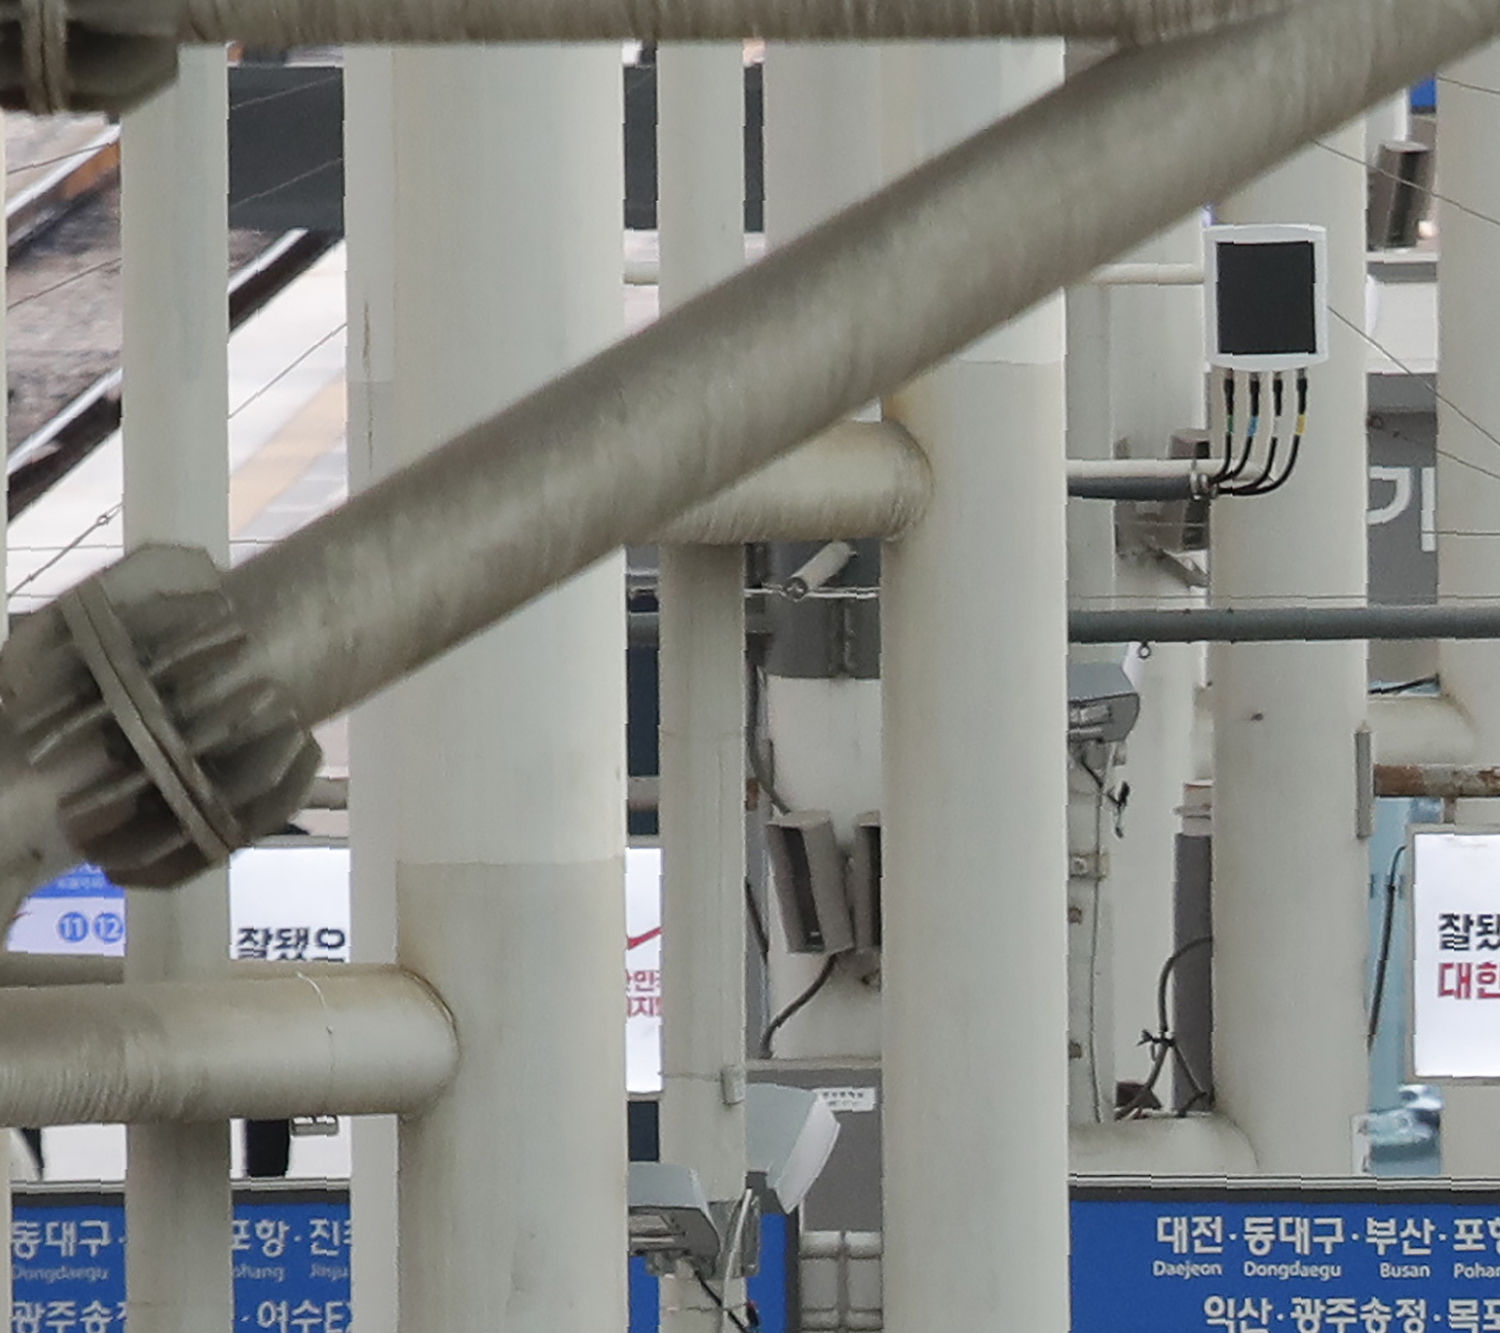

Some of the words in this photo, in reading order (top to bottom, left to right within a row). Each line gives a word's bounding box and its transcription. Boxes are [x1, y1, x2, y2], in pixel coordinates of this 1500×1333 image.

[1156, 1215, 1224, 1257] 대전
[1242, 1216, 1347, 1258] 동대구
[1364, 1216, 1435, 1258] 부산
[1152, 1260, 1223, 1281] Daejeon
[1243, 1260, 1342, 1283] Dongdaegu
[1379, 1261, 1431, 1279] Busan
